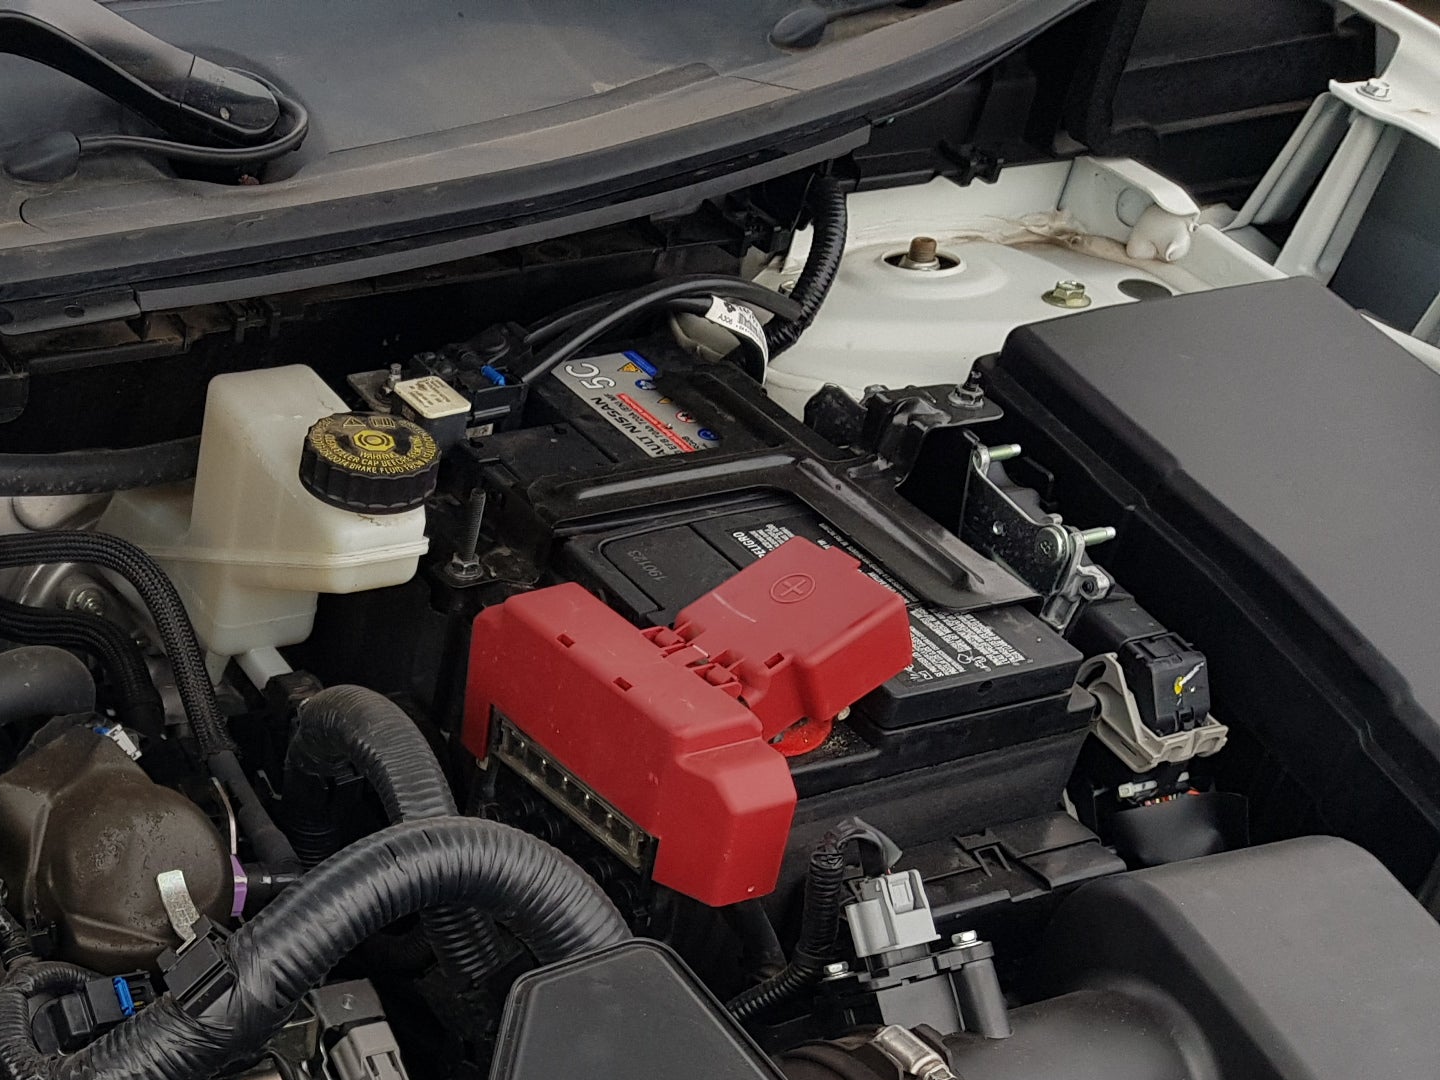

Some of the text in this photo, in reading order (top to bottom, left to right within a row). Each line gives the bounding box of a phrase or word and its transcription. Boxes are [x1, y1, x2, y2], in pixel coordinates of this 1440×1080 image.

[564, 363, 616, 390] 5C
[591, 397, 639, 434] NISSAN
[349, 463, 377, 474] BRAKE
[379, 466, 404, 474] FLUID
[361, 458, 379, 467] CAP
